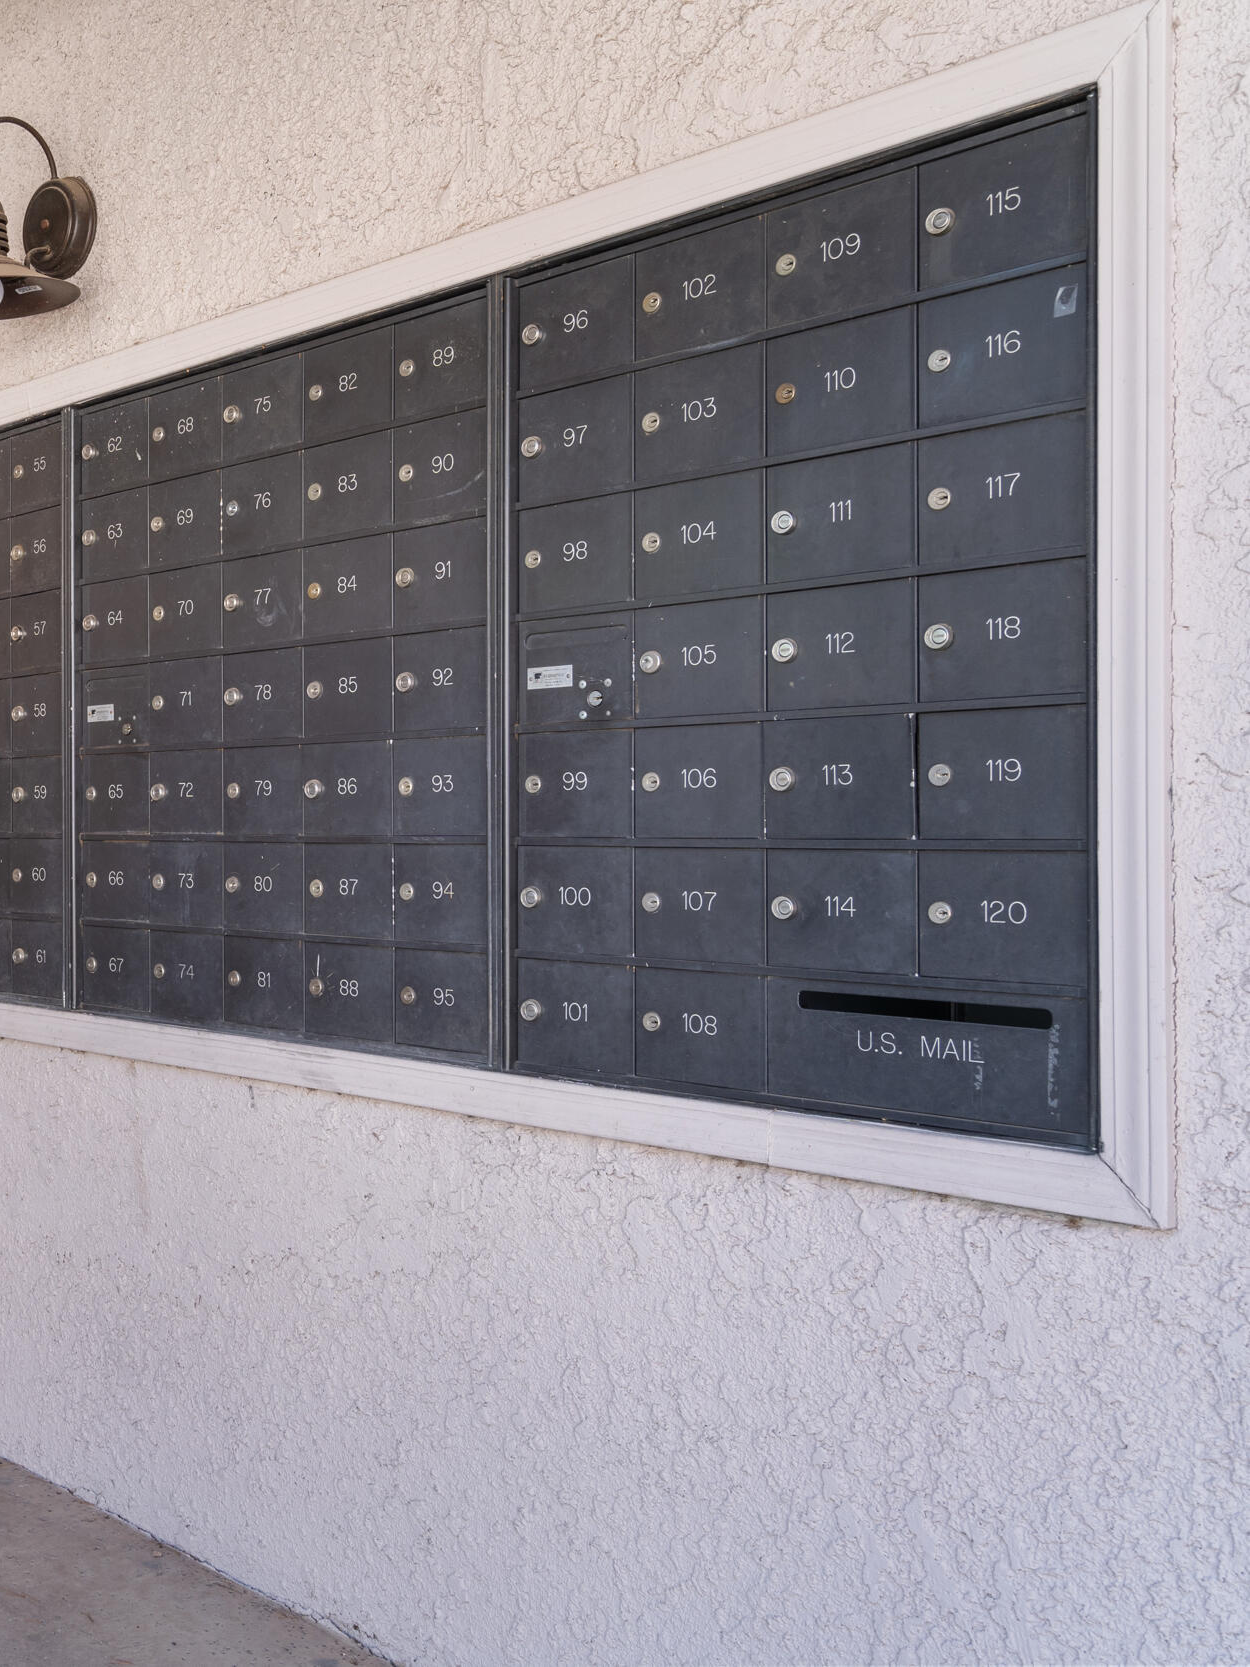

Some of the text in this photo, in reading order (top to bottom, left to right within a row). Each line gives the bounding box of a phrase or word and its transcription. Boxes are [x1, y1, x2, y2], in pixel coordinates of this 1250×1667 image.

[987, 187, 1020, 215] 115
[821, 233, 860, 262] 109
[683, 274, 716, 300] 102
[564, 310, 588, 332] 96
[986, 331, 1020, 357] 116
[433, 347, 454, 366] 89
[339, 373, 357, 391] 82
[825, 367, 855, 392] 110
[254, 396, 271, 414] 75
[682, 397, 716, 422] 103
[178, 417, 193, 434] 68
[108, 436, 122, 452] 62
[564, 425, 587, 447] 97
[34, 456, 46, 471] 55
[432, 454, 454, 473] 90
[338, 474, 357, 492] 83
[986, 473, 1020, 499] 117
[254, 492, 271, 509] 76
[177, 509, 193, 525] 69
[830, 500, 851, 522] 111
[108, 524, 122, 539] 63
[681, 521, 716, 544] 104
[34, 539, 46, 553] 56
[563, 541, 587, 561] 98
[435, 561, 450, 579] 91
[338, 576, 357, 593] 84
[255, 588, 271, 605] 77
[178, 600, 193, 615] 70
[108, 610, 123, 625] 64
[34, 621, 46, 635] 57
[986, 616, 1020, 640] 118
[826, 632, 854, 654] 112
[682, 645, 716, 666] 105
[339, 677, 357, 693] 85
[433, 668, 453, 686] 92
[180, 691, 191, 706] 71
[255, 684, 271, 700] 78
[34, 703, 46, 717] 58
[682, 768, 716, 788] 106
[822, 764, 852, 785] 113
[986, 759, 1021, 781] 119
[179, 783, 193, 797] 72
[255, 780, 271, 796] 79
[338, 778, 357, 794] 86
[432, 775, 453, 792] 93
[563, 772, 587, 790] 99
[34, 786, 46, 799] 59
[109, 784, 123, 798] 65
[32, 868, 46, 881] 60
[109, 871, 123, 885] 66
[179, 873, 193, 888] 73
[254, 876, 272, 891] 80
[340, 879, 358, 895] 87
[433, 882, 454, 899] 94
[559, 887, 591, 906] 100
[682, 891, 716, 911] 107
[825, 896, 856, 917] 114
[981, 901, 1027, 924] 120
[36, 949, 45, 963] 61
[109, 958, 123, 972] 67
[179, 964, 194, 978] 74
[258, 972, 270, 987] 81
[340, 980, 358, 996] 88
[434, 988, 454, 1006] 95
[563, 1002, 587, 1021] 101
[683, 1013, 717, 1035] 108
[858, 1030, 984, 1063] U.S. MAIL
